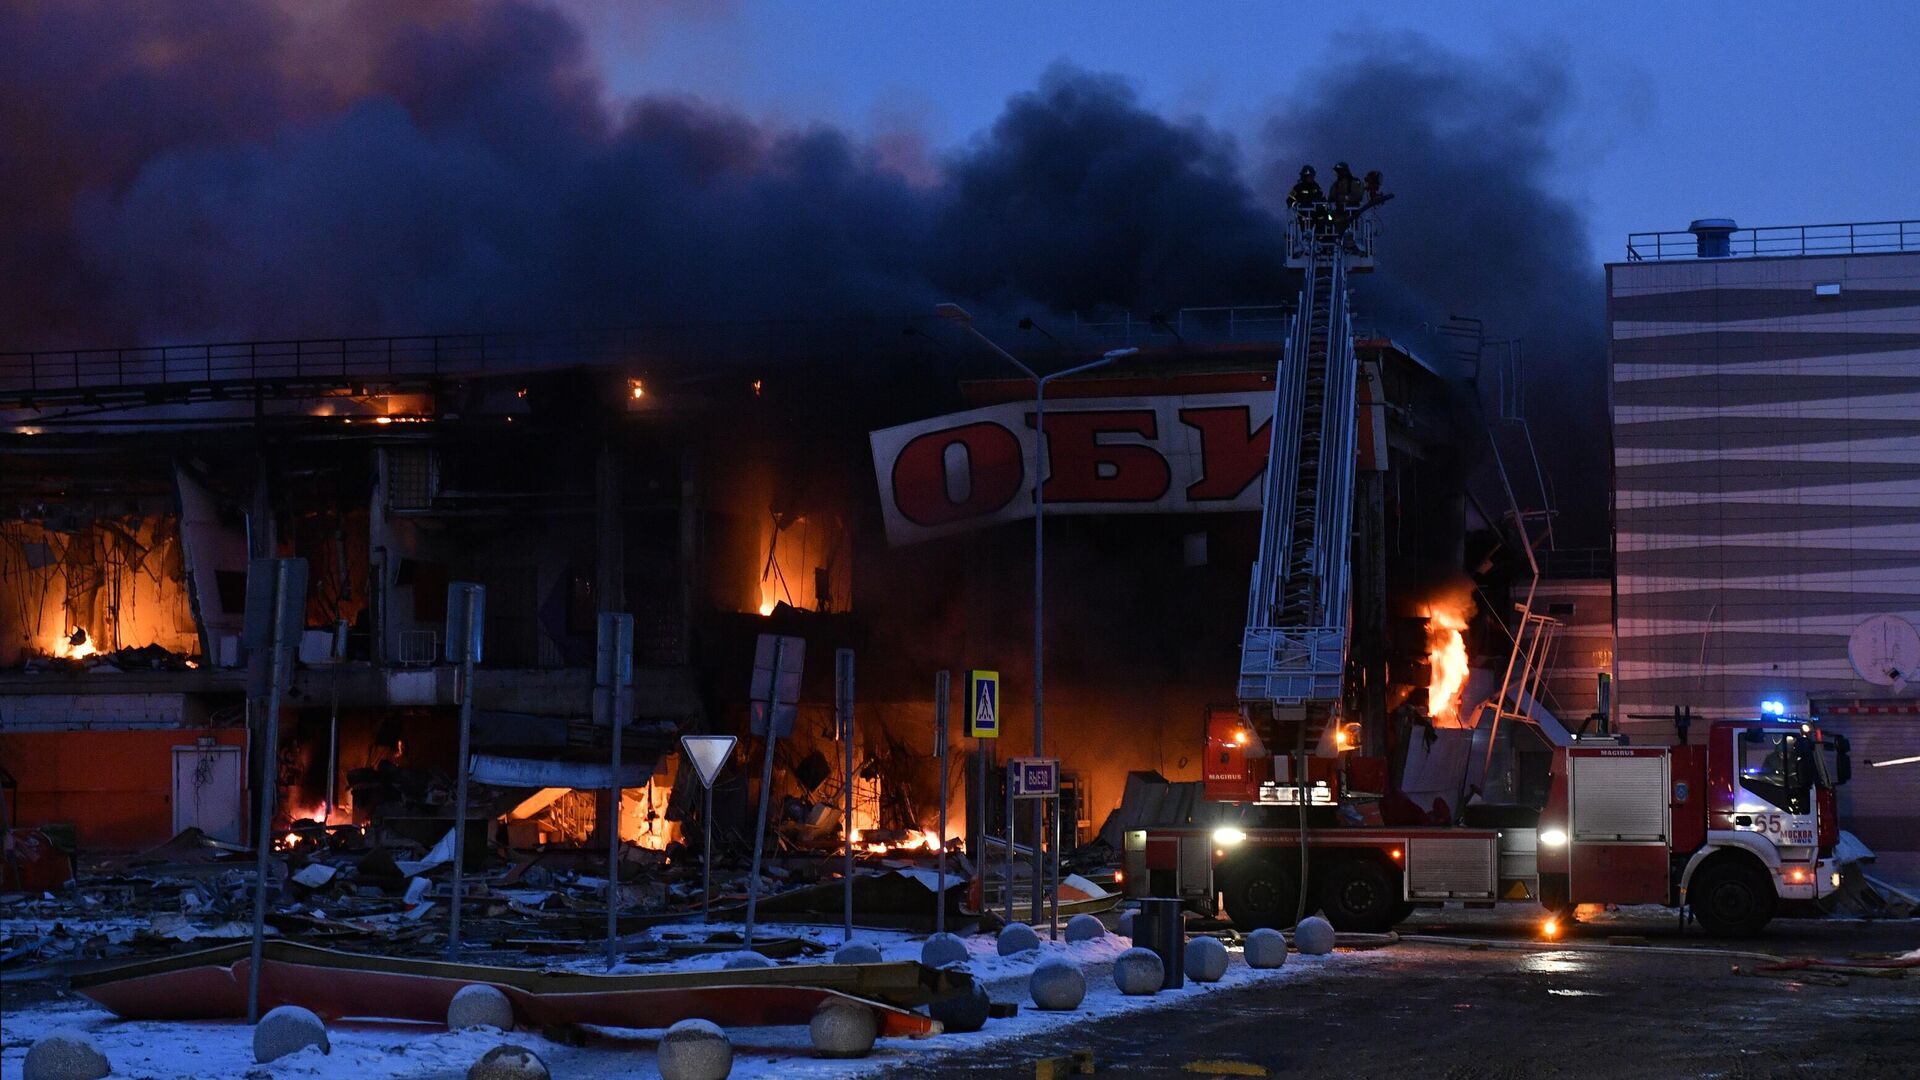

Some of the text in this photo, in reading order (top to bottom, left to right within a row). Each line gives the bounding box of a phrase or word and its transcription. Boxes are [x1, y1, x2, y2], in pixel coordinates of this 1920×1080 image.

[891, 405, 1273, 527] ОБИ
[1028, 770, 1048, 787] ВЫЕЗД
[1754, 814, 1781, 834] 65
[1780, 829, 1813, 839] МОСКВА
